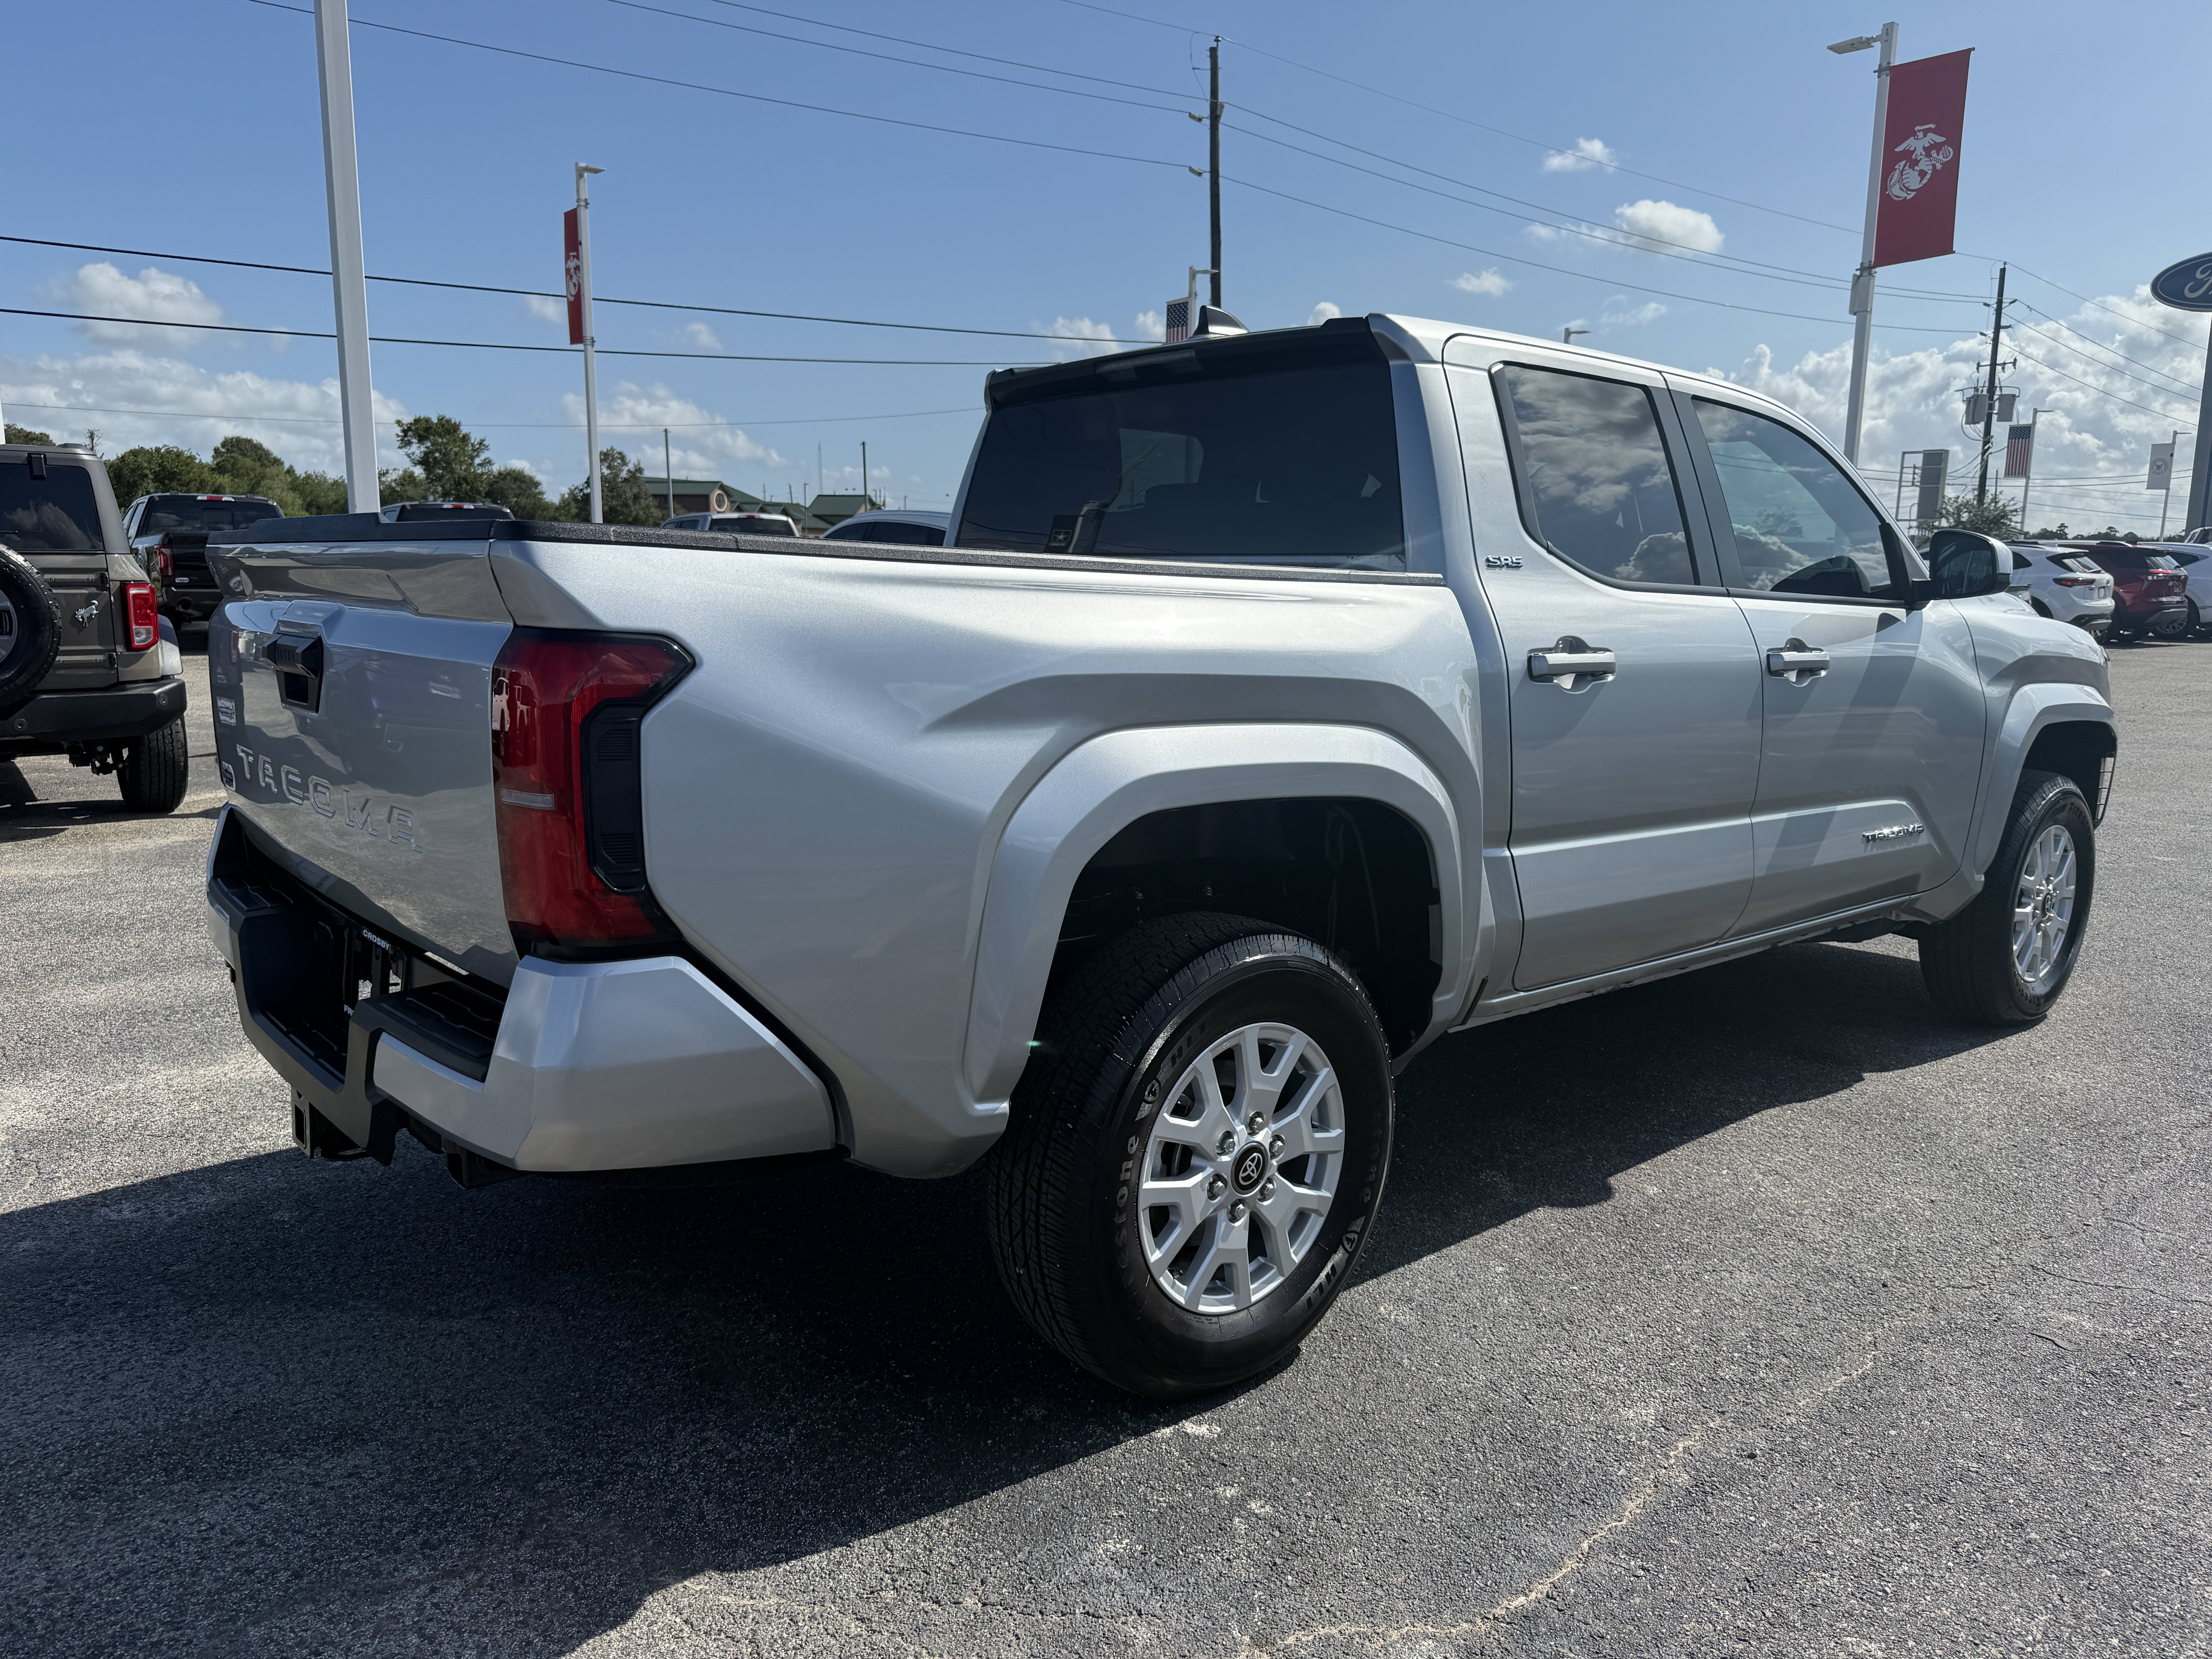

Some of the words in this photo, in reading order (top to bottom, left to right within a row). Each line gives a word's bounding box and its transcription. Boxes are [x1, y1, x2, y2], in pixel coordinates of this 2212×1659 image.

[1485, 555, 1523, 568] SR5
[277, 646, 295, 663] TOYOT
[237, 744, 422, 853] TACOMA
[1862, 824, 1924, 843] TACOMA
[362, 929, 390, 950] CROSBY
[343, 1004, 354, 1016] FR
